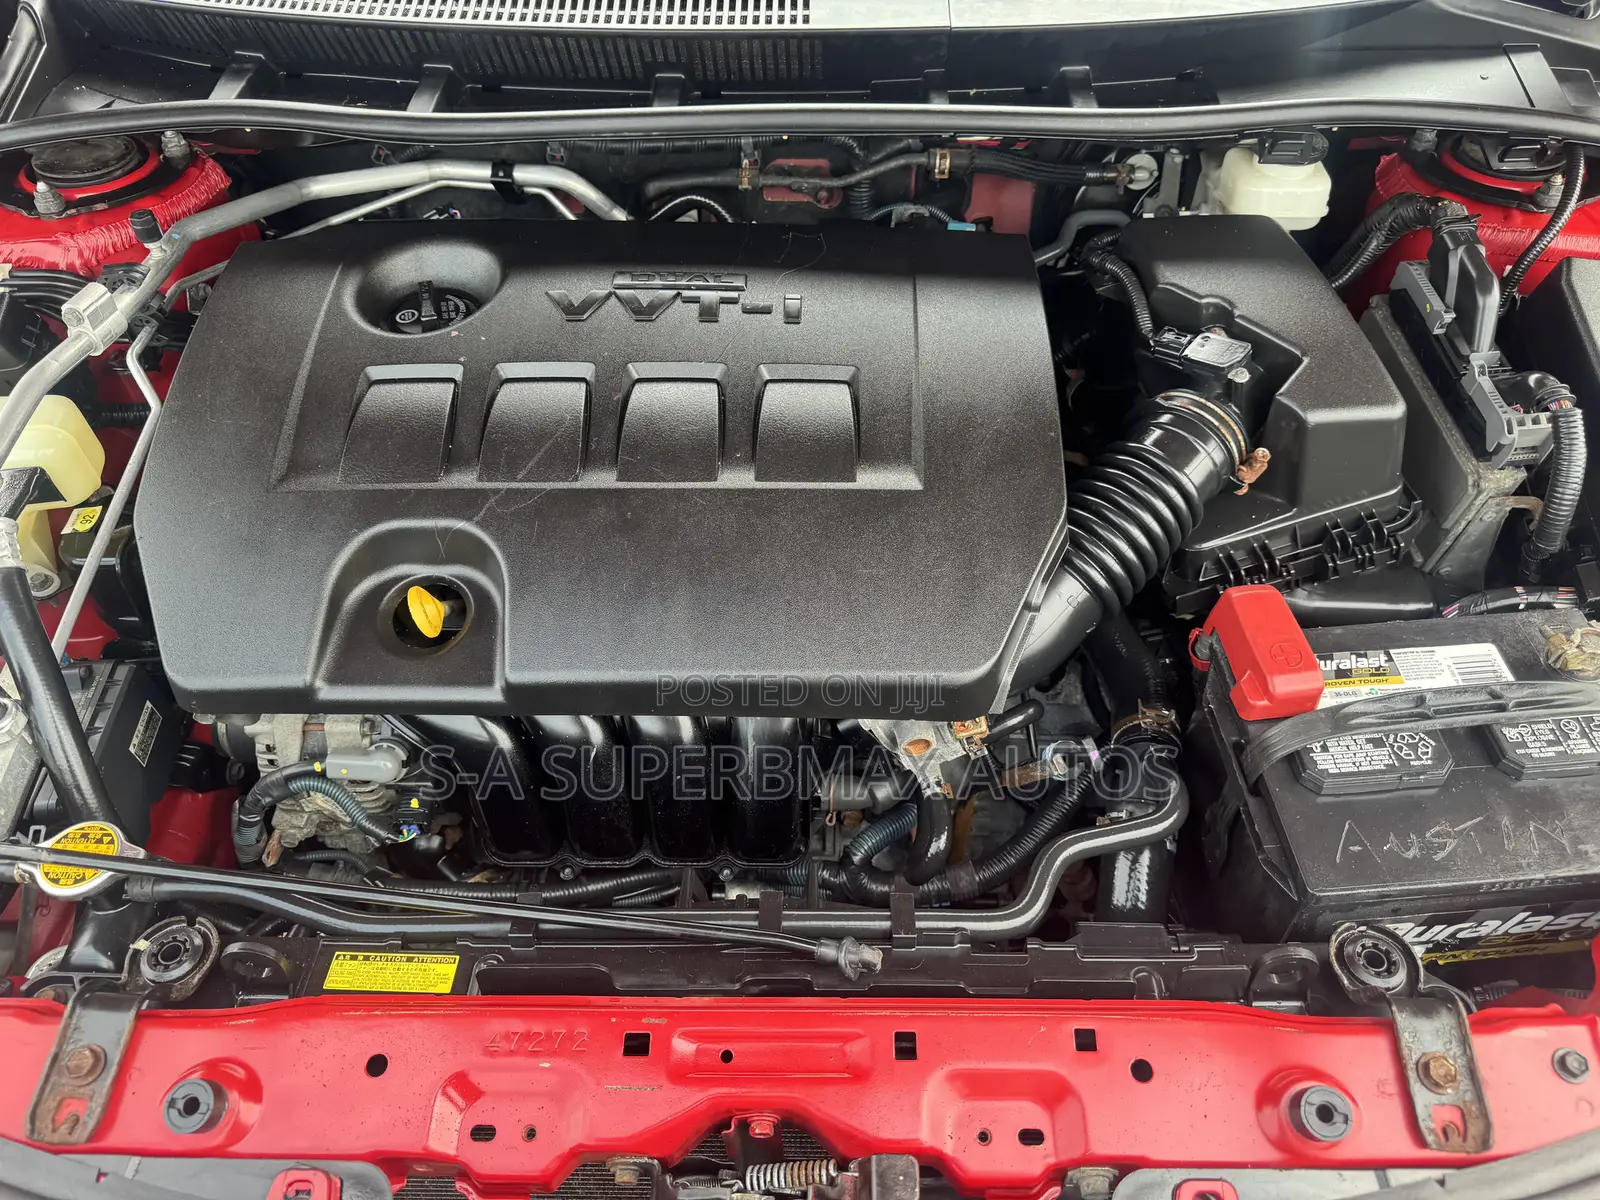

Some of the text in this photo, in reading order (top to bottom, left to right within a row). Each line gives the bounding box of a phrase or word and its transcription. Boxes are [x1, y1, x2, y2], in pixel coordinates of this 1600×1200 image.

[630, 272, 734, 284] DUAL
[545, 289, 802, 324] VVT-i
[1316, 653, 1388, 671] uralast
[1352, 667, 1391, 675] GOLD
[47, 871, 83, 879] CAUTION
[412, 956, 455, 964] ATTENTION
[485, 1029, 590, 1052] 47272
